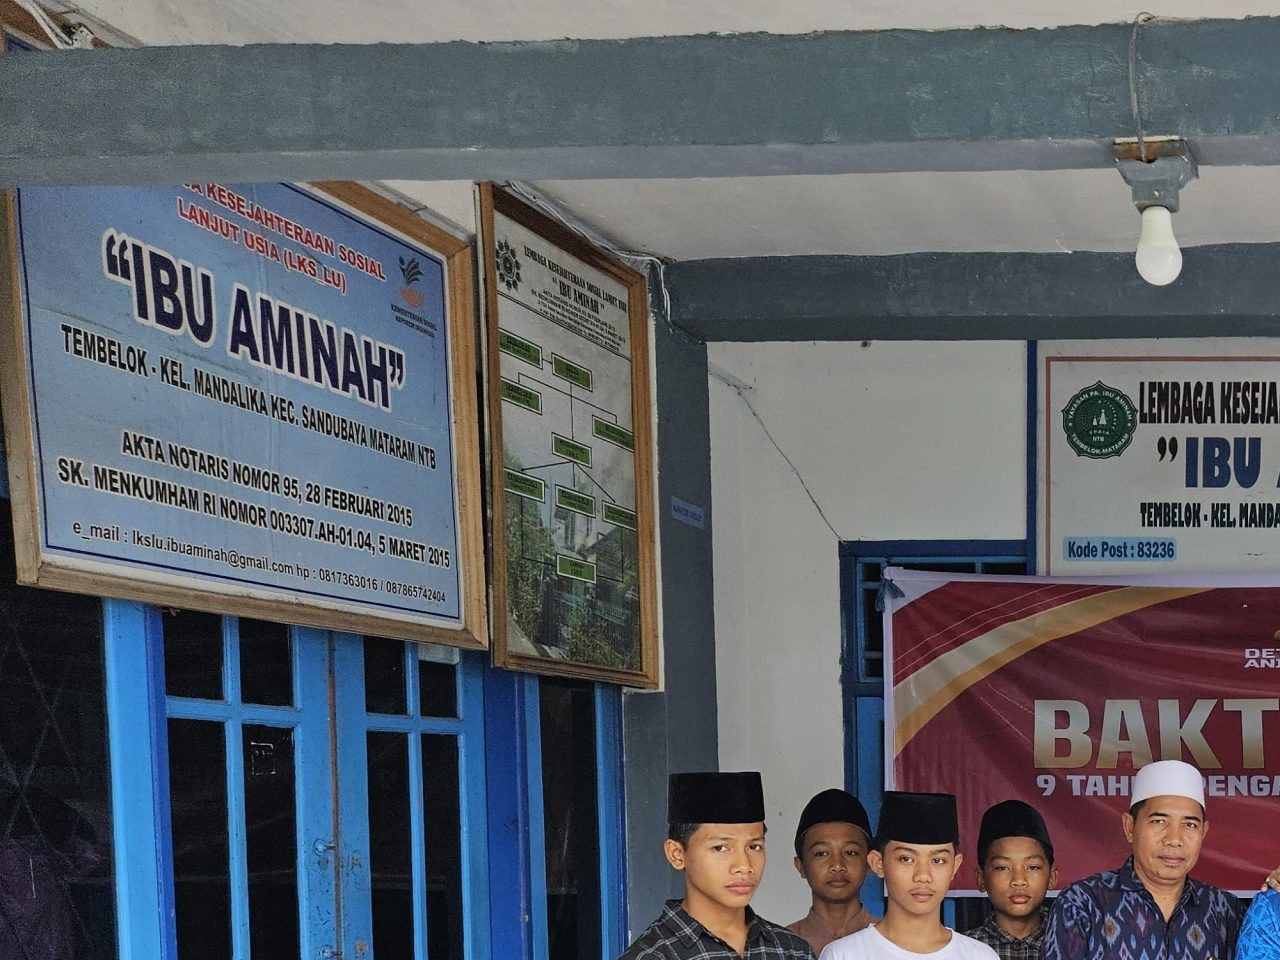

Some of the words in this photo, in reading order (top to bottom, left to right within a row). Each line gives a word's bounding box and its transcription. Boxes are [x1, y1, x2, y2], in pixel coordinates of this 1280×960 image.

[177, 197, 239, 242] LANJUT
[243, 230, 279, 261] USIA
[284, 250, 346, 294] (LKS_LU)
[207, 183, 334, 256] KESEJAHTERAAN
[338, 244, 386, 280] SOSIAL
[61, 323, 148, 377] TEMBELOK
[160, 356, 190, 391] KEL.
[194, 368, 268, 416] MANDALIKA
[271, 394, 299, 426] KEC.
[302, 404, 367, 447] SANDUBAYA
[370, 427, 415, 464] MATARAM
[418, 444, 436, 470] NTB
[1139, 381, 1217, 425] LEMBAGA
[58, 457, 88, 486] SK.
[93, 465, 200, 512] MENKUMHAM
[203, 491, 216, 516] RI
[219, 496, 267, 528] NOMOR
[378, 535, 386, 554] 5
[389, 537, 425, 563] MARET
[428, 546, 450, 568] 2015
[122, 431, 165, 463] AKTA
[168, 443, 229, 481] NOTARIS
[232, 461, 280, 495] NOMOR
[283, 475, 301, 503] 95,
[305, 482, 321, 504] 28
[324, 486, 385, 520] FEBRUARI
[387, 503, 413, 527] 2015
[1140, 502, 1201, 528] TEMBELOK
[73, 522, 119, 541] e_mail
[296, 563, 310, 581] hp
[319, 567, 378, 592] 0817363016
[1068, 541, 1098, 559] Kode
[1101, 541, 1128, 559] Post
[1137, 541, 1175, 559] 83236
[1036, 774, 1056, 796] 9
[1067, 774, 1134, 796] TAH
